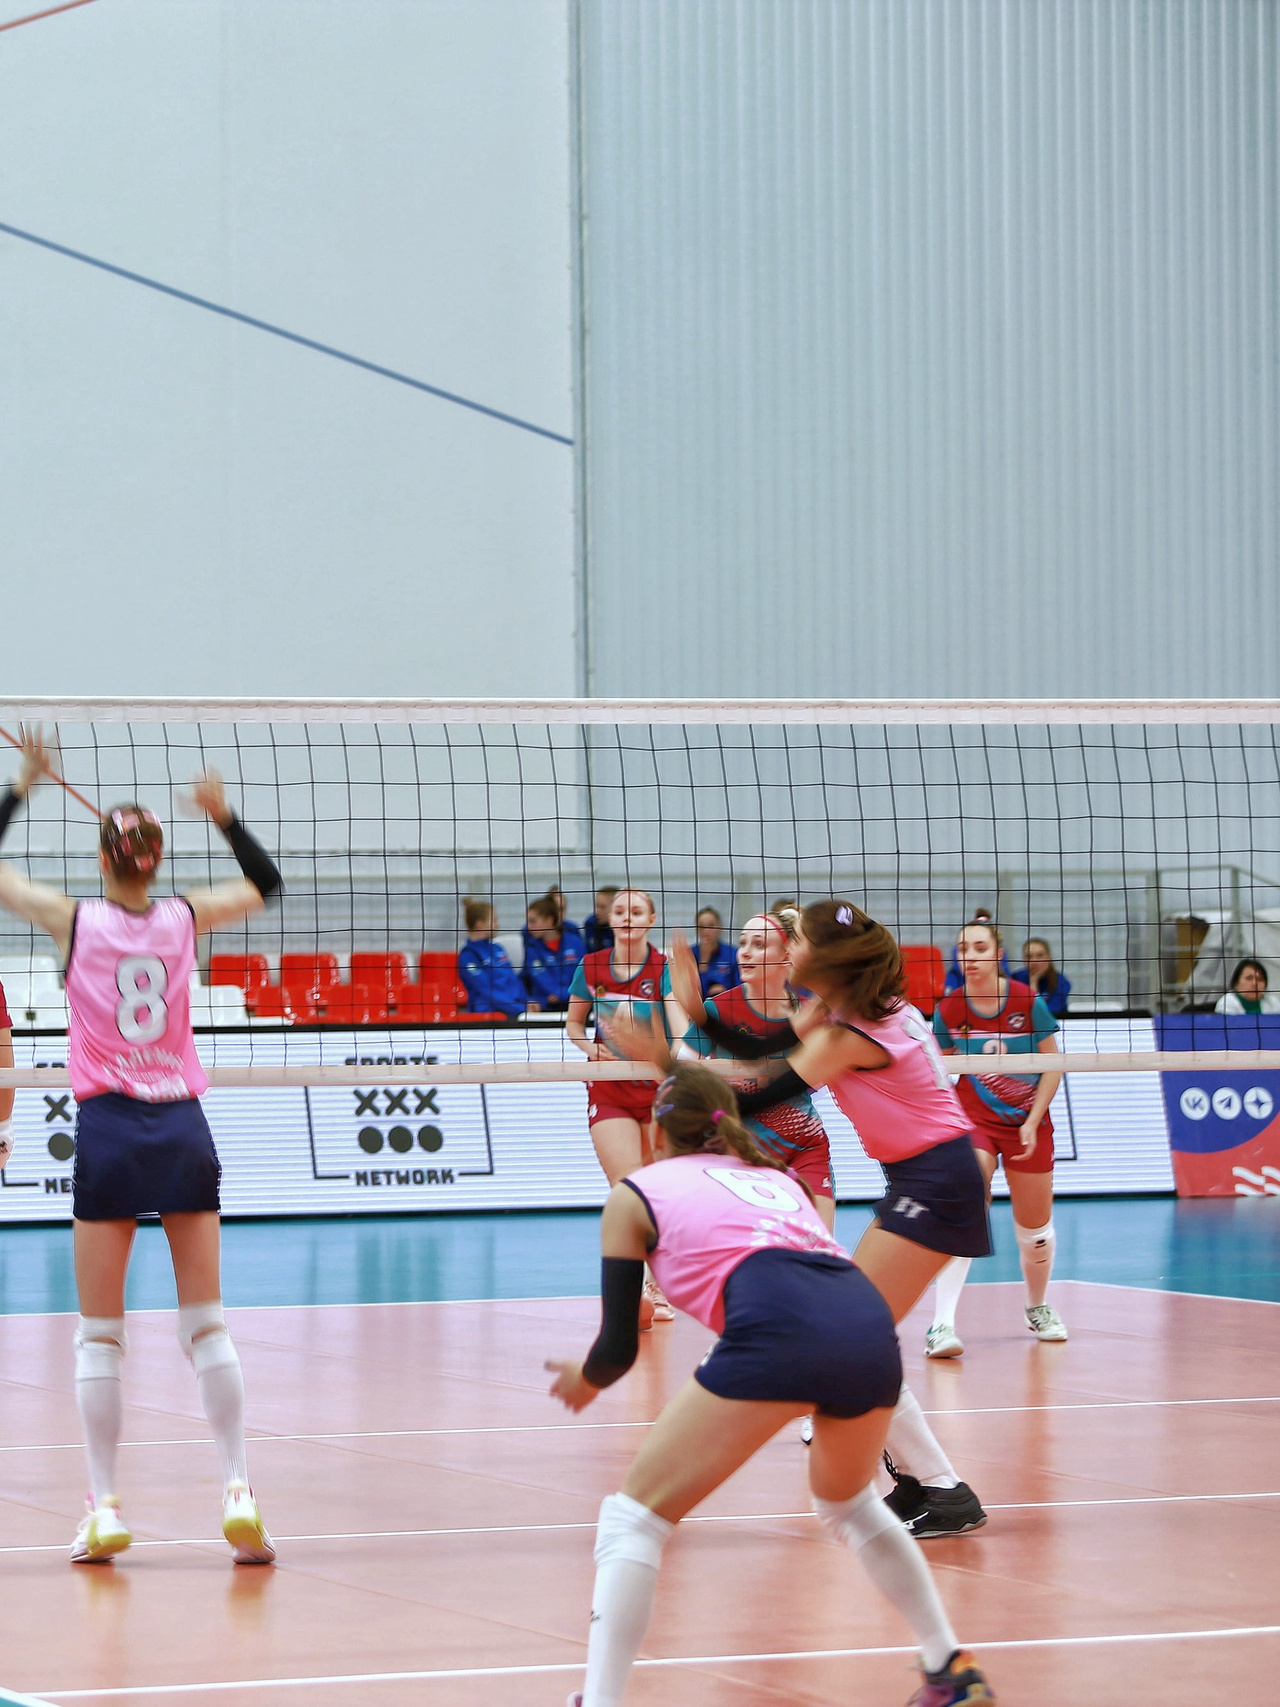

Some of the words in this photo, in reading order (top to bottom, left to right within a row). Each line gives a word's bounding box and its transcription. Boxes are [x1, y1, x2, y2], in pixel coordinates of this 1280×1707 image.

[115, 953, 168, 1045] 8
[355, 1168, 455, 1187] NETWORK
[703, 1166, 803, 1213] 6
